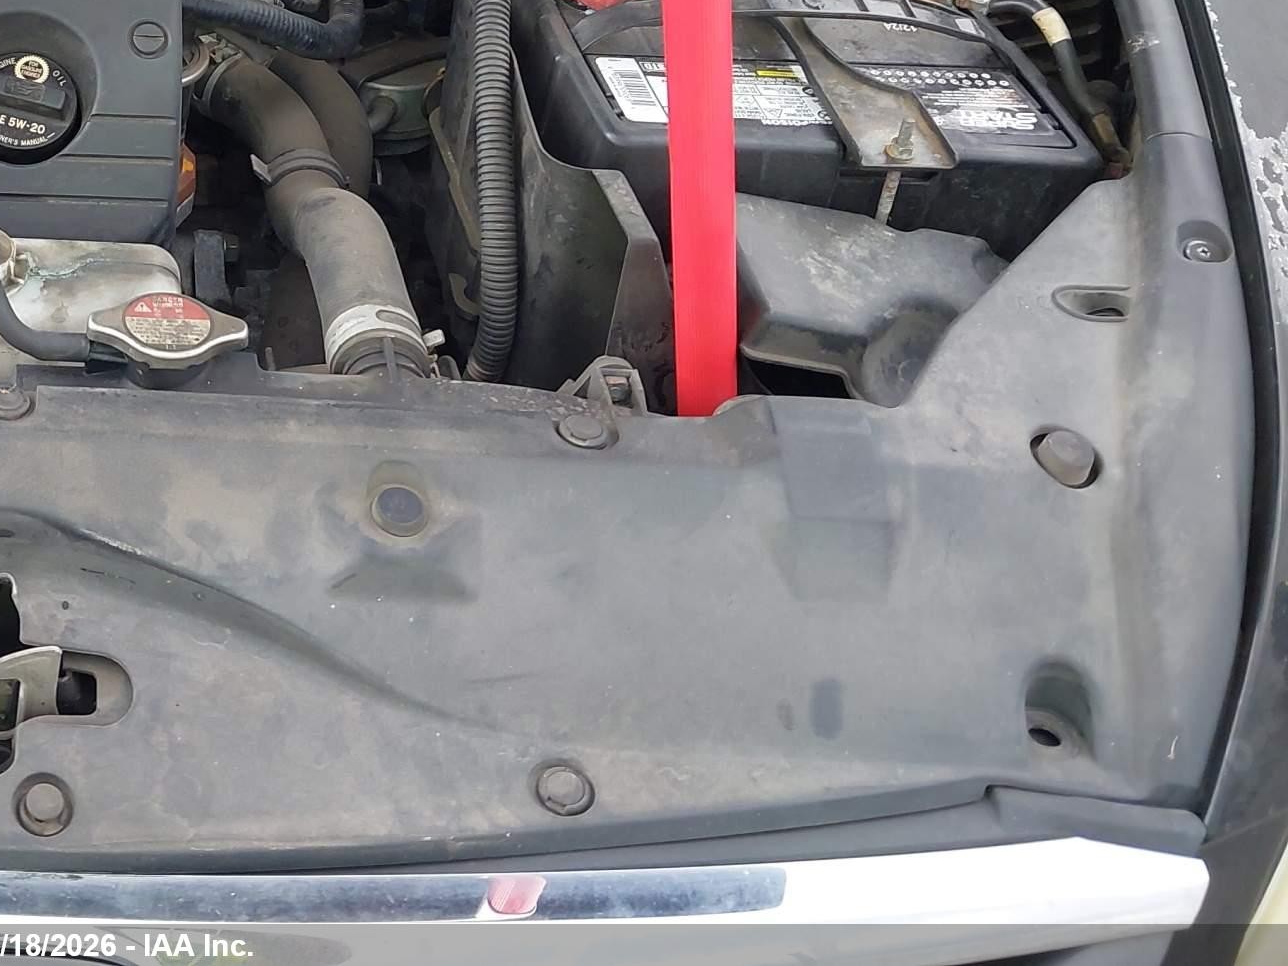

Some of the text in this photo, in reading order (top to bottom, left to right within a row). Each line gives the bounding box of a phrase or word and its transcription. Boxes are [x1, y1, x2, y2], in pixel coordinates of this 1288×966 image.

[52, 70, 67, 87] OIL
[8, 117, 46, 134] 5W-20
[20, 135, 49, 147] MANUAL
